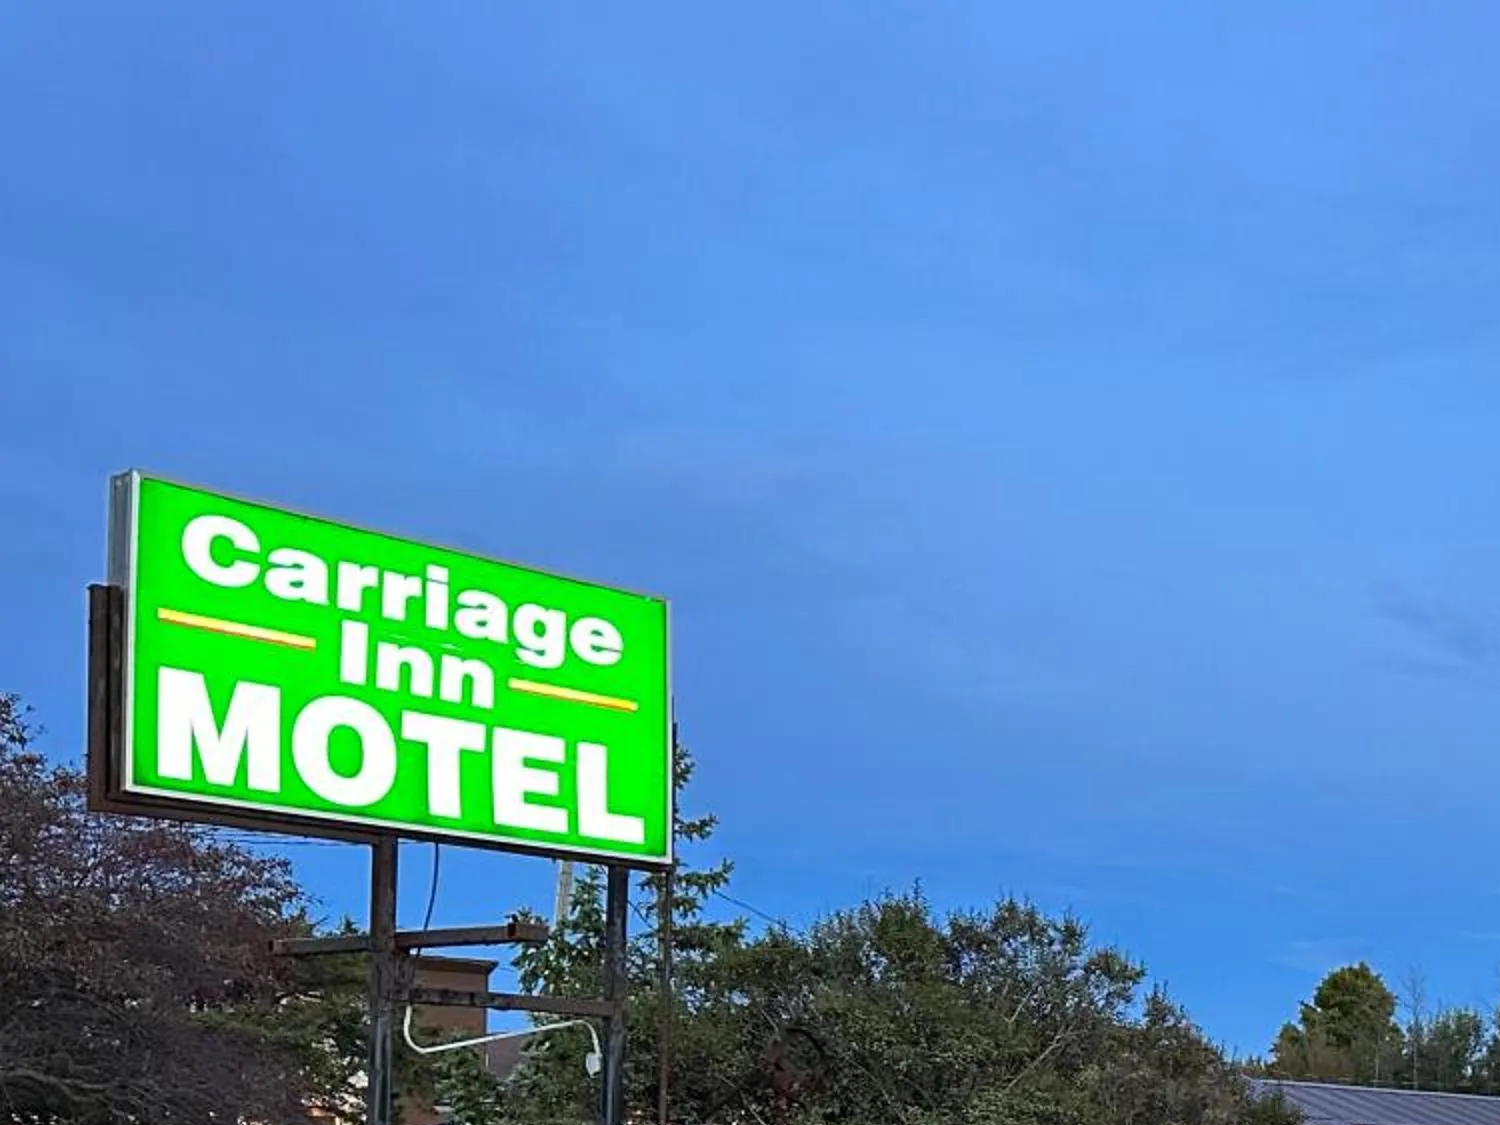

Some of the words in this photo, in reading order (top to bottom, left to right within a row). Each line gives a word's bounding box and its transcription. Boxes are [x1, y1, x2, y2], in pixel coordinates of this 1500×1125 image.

[182, 515, 623, 668] Carriage
[340, 620, 494, 709] Inn
[157, 666, 645, 844] MOTEL
